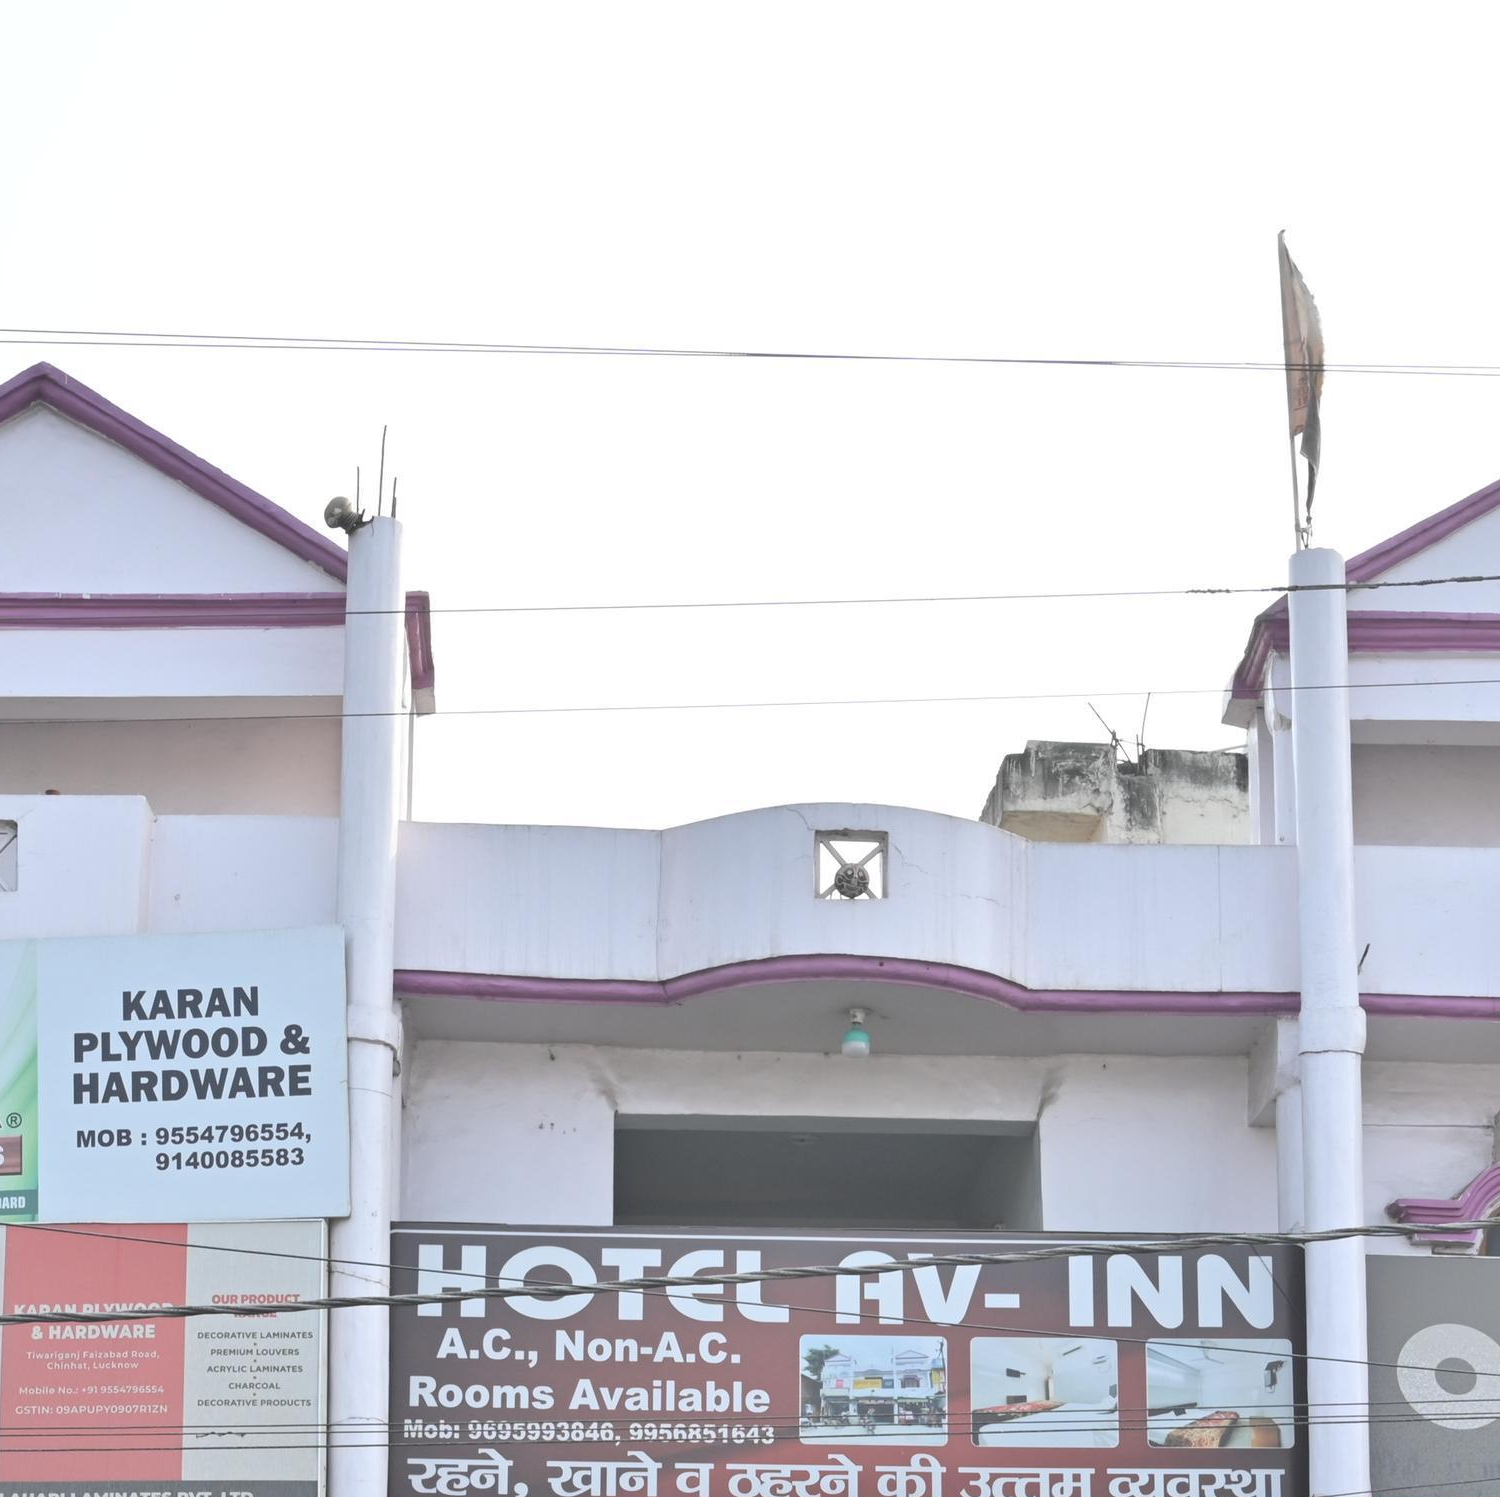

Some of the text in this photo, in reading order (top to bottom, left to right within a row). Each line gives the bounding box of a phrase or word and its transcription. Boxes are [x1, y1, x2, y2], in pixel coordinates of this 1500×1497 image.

[122, 986, 259, 1021] KARAN
[73, 1024, 310, 1062] PLYWOOD &
[73, 1065, 312, 1105] HARDWARE
[76, 1122, 311, 1148] MOB 9554796554,
[155, 1148, 305, 1171] 9140085583
[417, 1244, 1274, 1329] HOTEL AV- INN
[212, 1294, 238, 1304] OUR
[49, 1324, 156, 1339] HARDWARE
[260, 1331, 313, 1339] LAMINATES
[83, 1350, 129, 1359] Faizabad
[210, 1348, 300, 1356] PREMIUM LOUVERS
[555, 1330, 741, 1363] Non-A.C.
[93, 1361, 139, 1369] Lucknow
[207, 1365, 303, 1373] ACRYLIC LAMINATES
[228, 1382, 281, 1390] CHARCOAL
[408, 1375, 770, 1413] Rooms Available
[197, 1399, 311, 1407] DECORATIVE PRODUCTS
[547, 1451, 662, 1497] खाने
